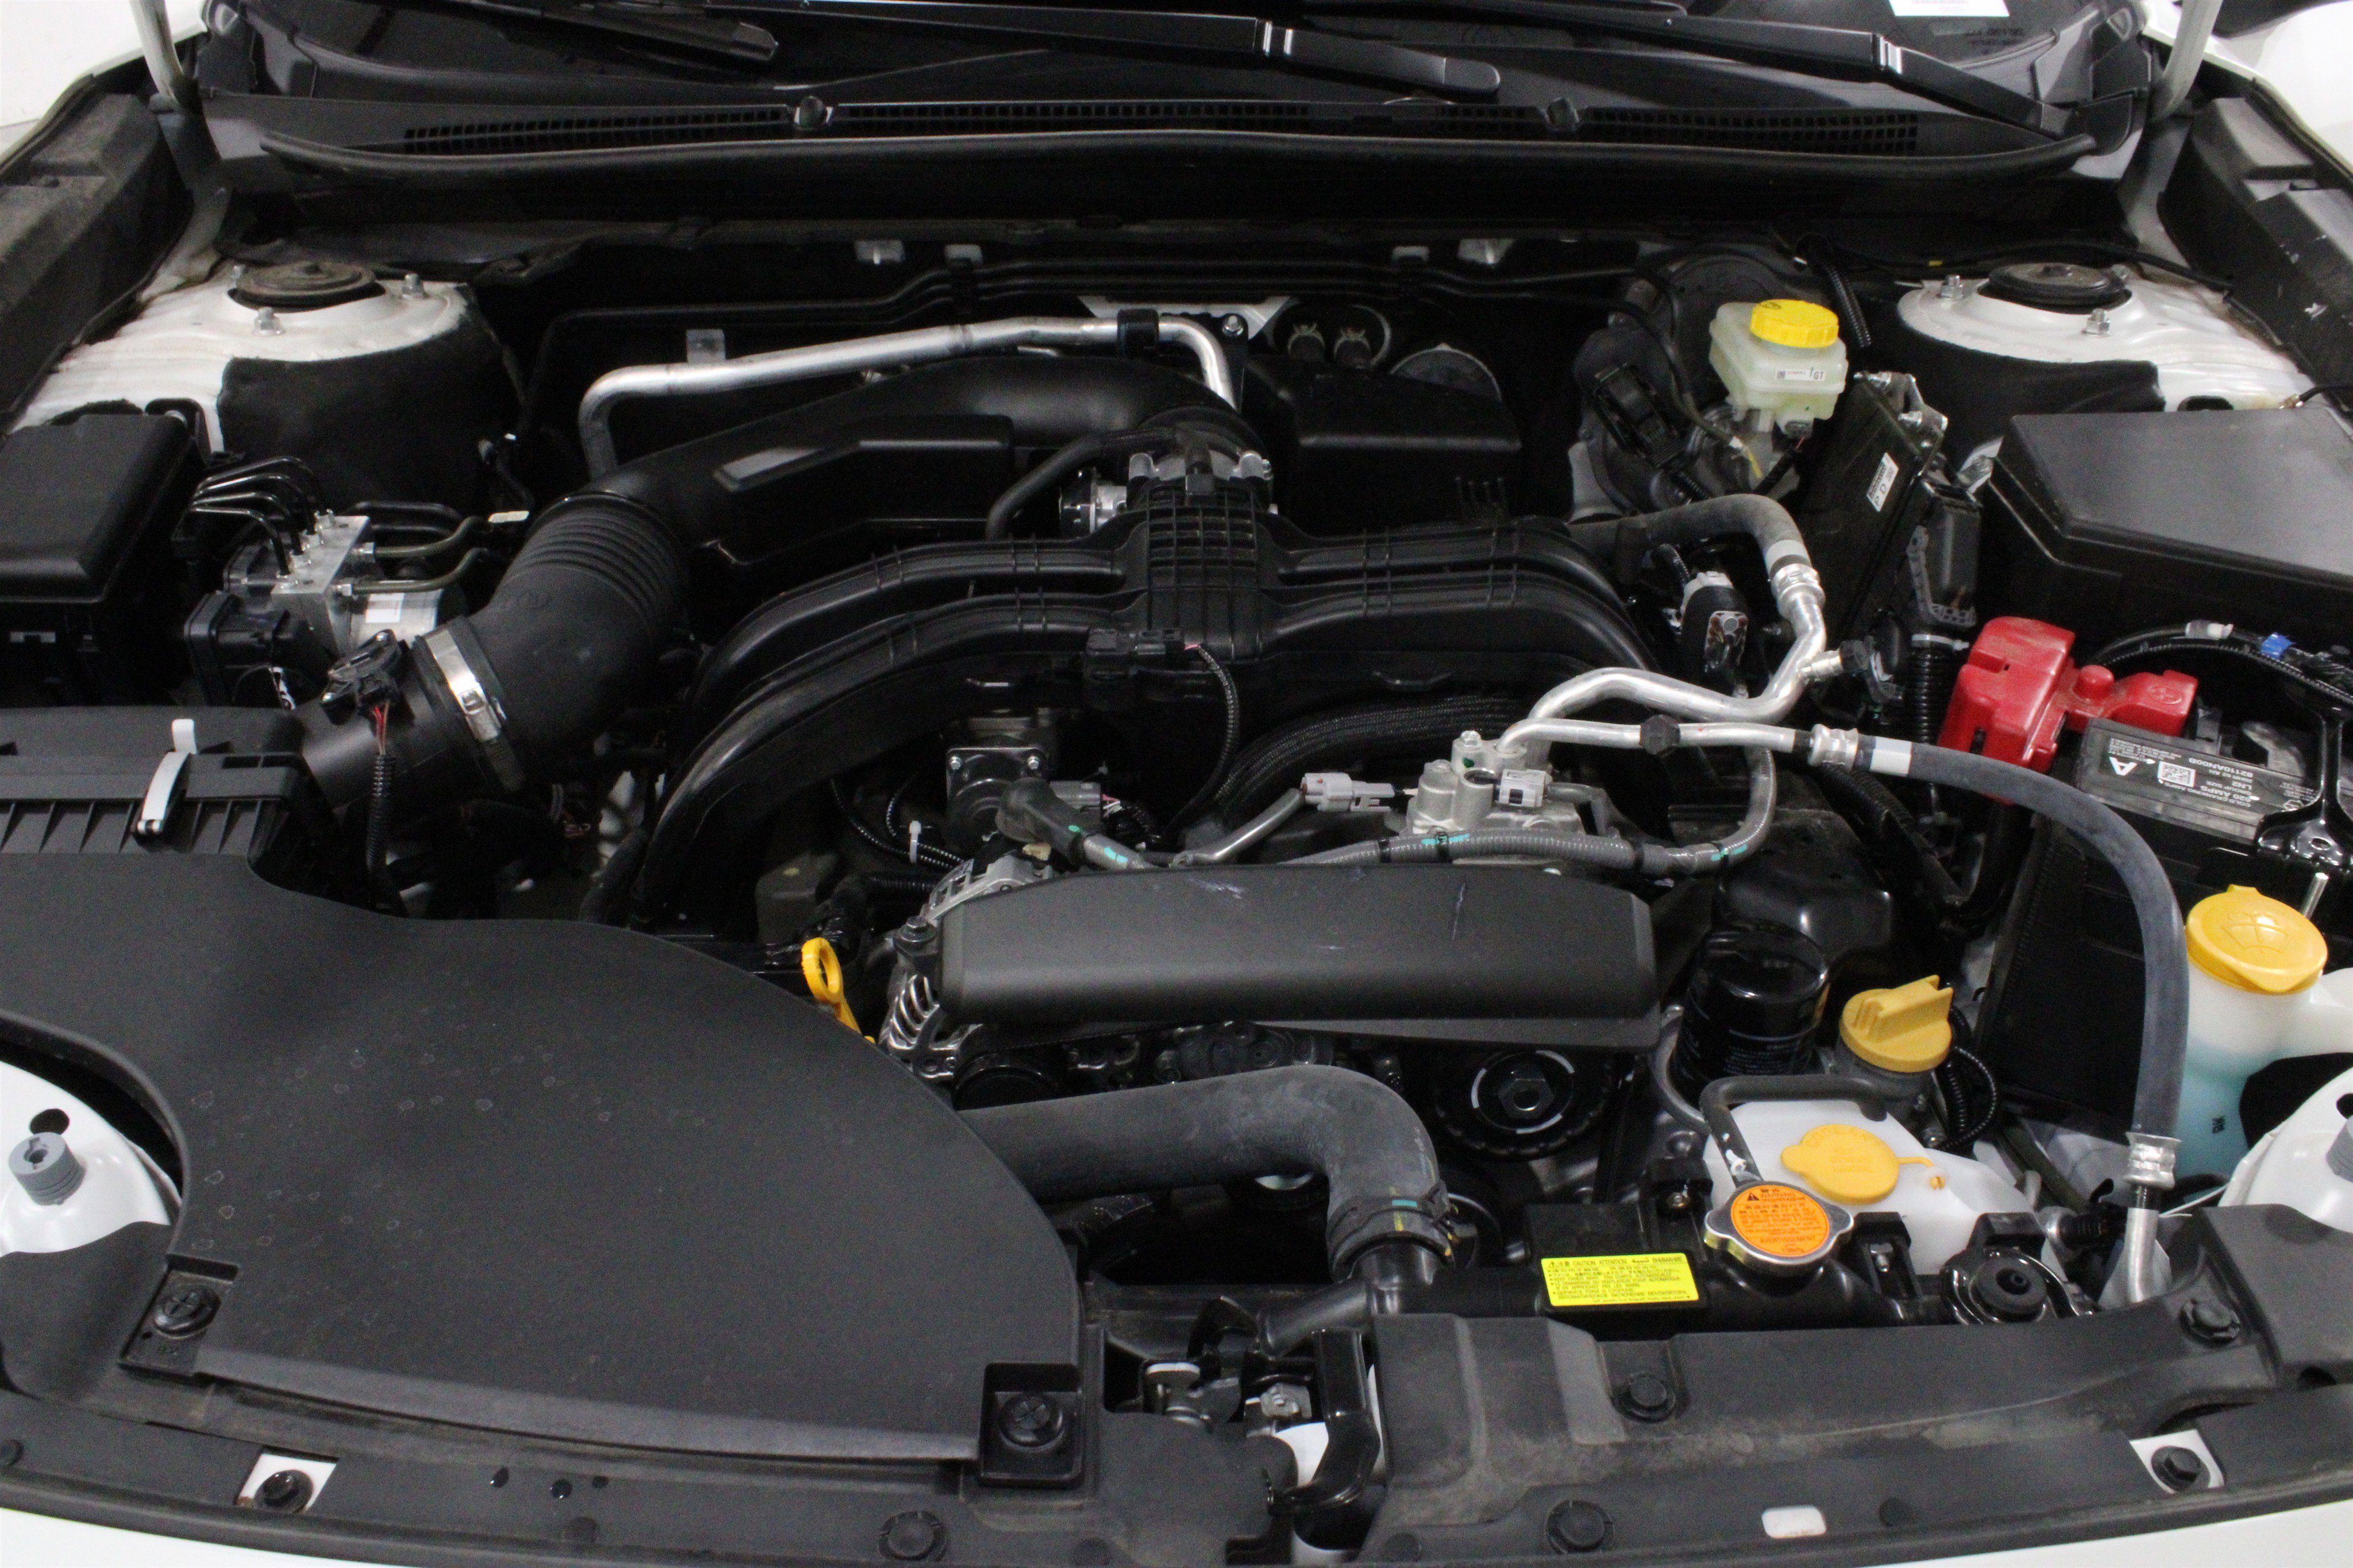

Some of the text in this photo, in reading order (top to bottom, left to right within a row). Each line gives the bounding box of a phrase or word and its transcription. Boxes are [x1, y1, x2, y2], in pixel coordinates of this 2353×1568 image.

[2231, 781, 2252, 790] LN2
[2187, 788, 2228, 802] CRANKING
[2200, 785, 2231, 797] AMPS
[2229, 799, 2251, 807] COLD
